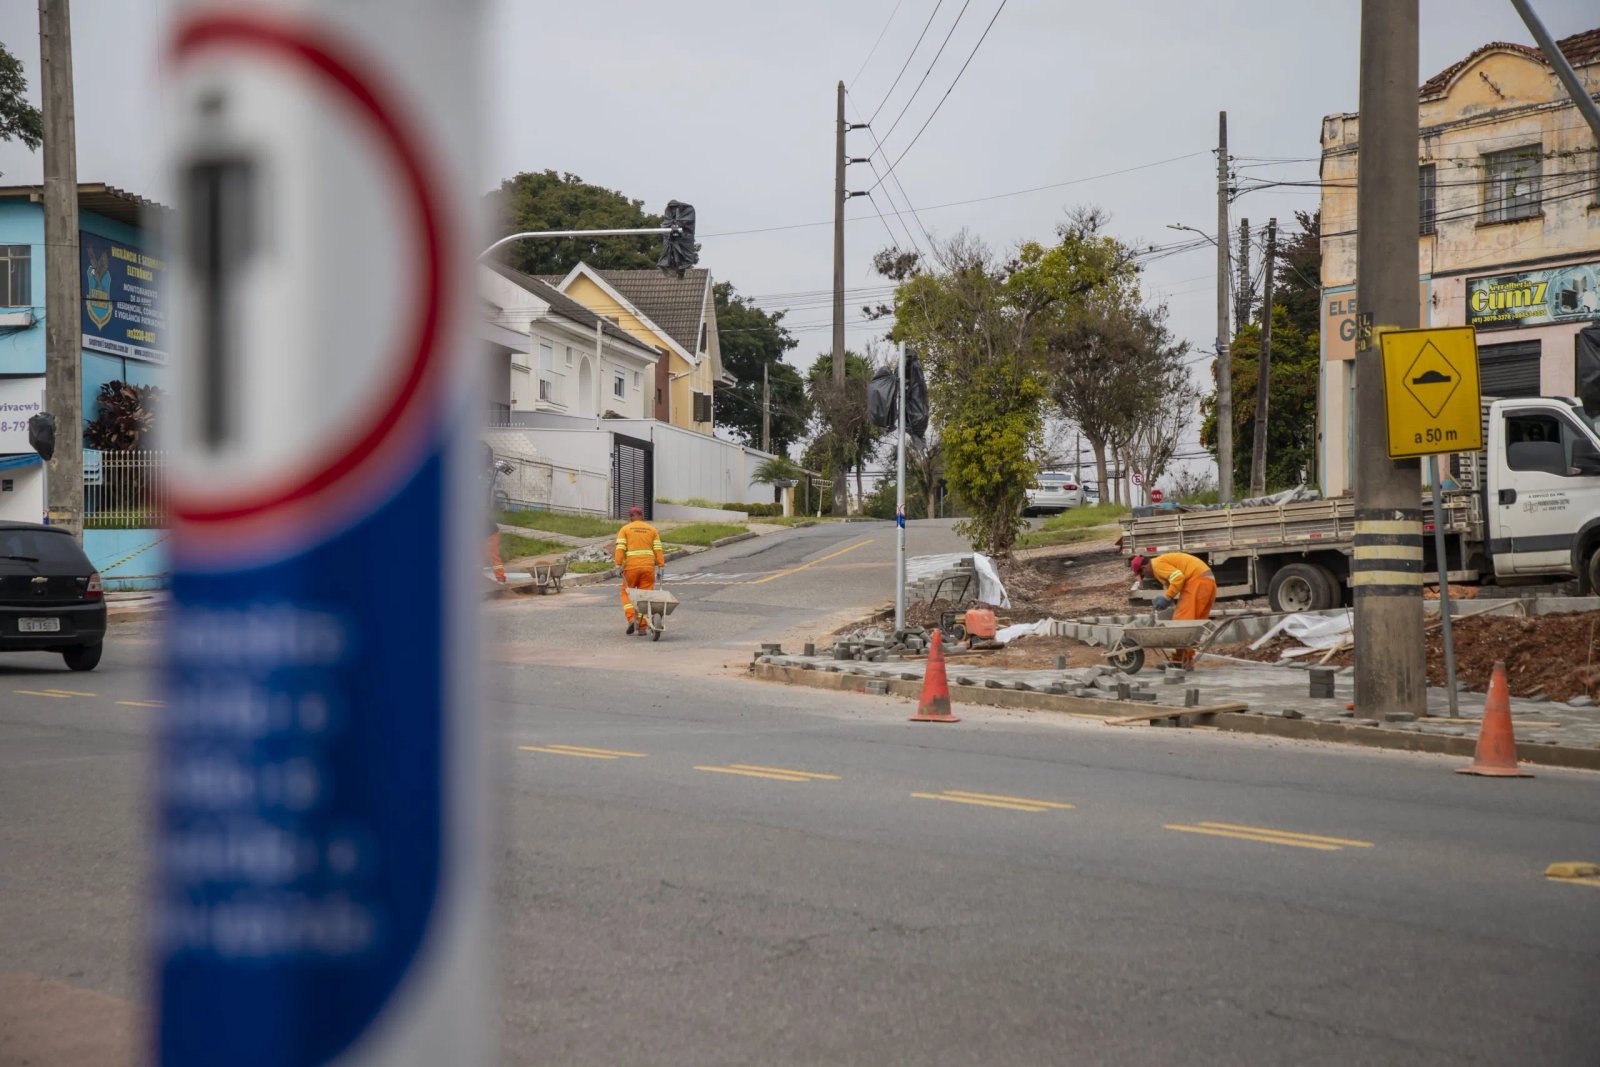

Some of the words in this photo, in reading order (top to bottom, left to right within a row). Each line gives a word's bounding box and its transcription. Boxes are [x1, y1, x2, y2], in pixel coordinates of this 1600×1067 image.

[1414, 433, 1422, 443] a
[1426, 428, 1442, 442] 50
[1446, 430, 1457, 440] m
